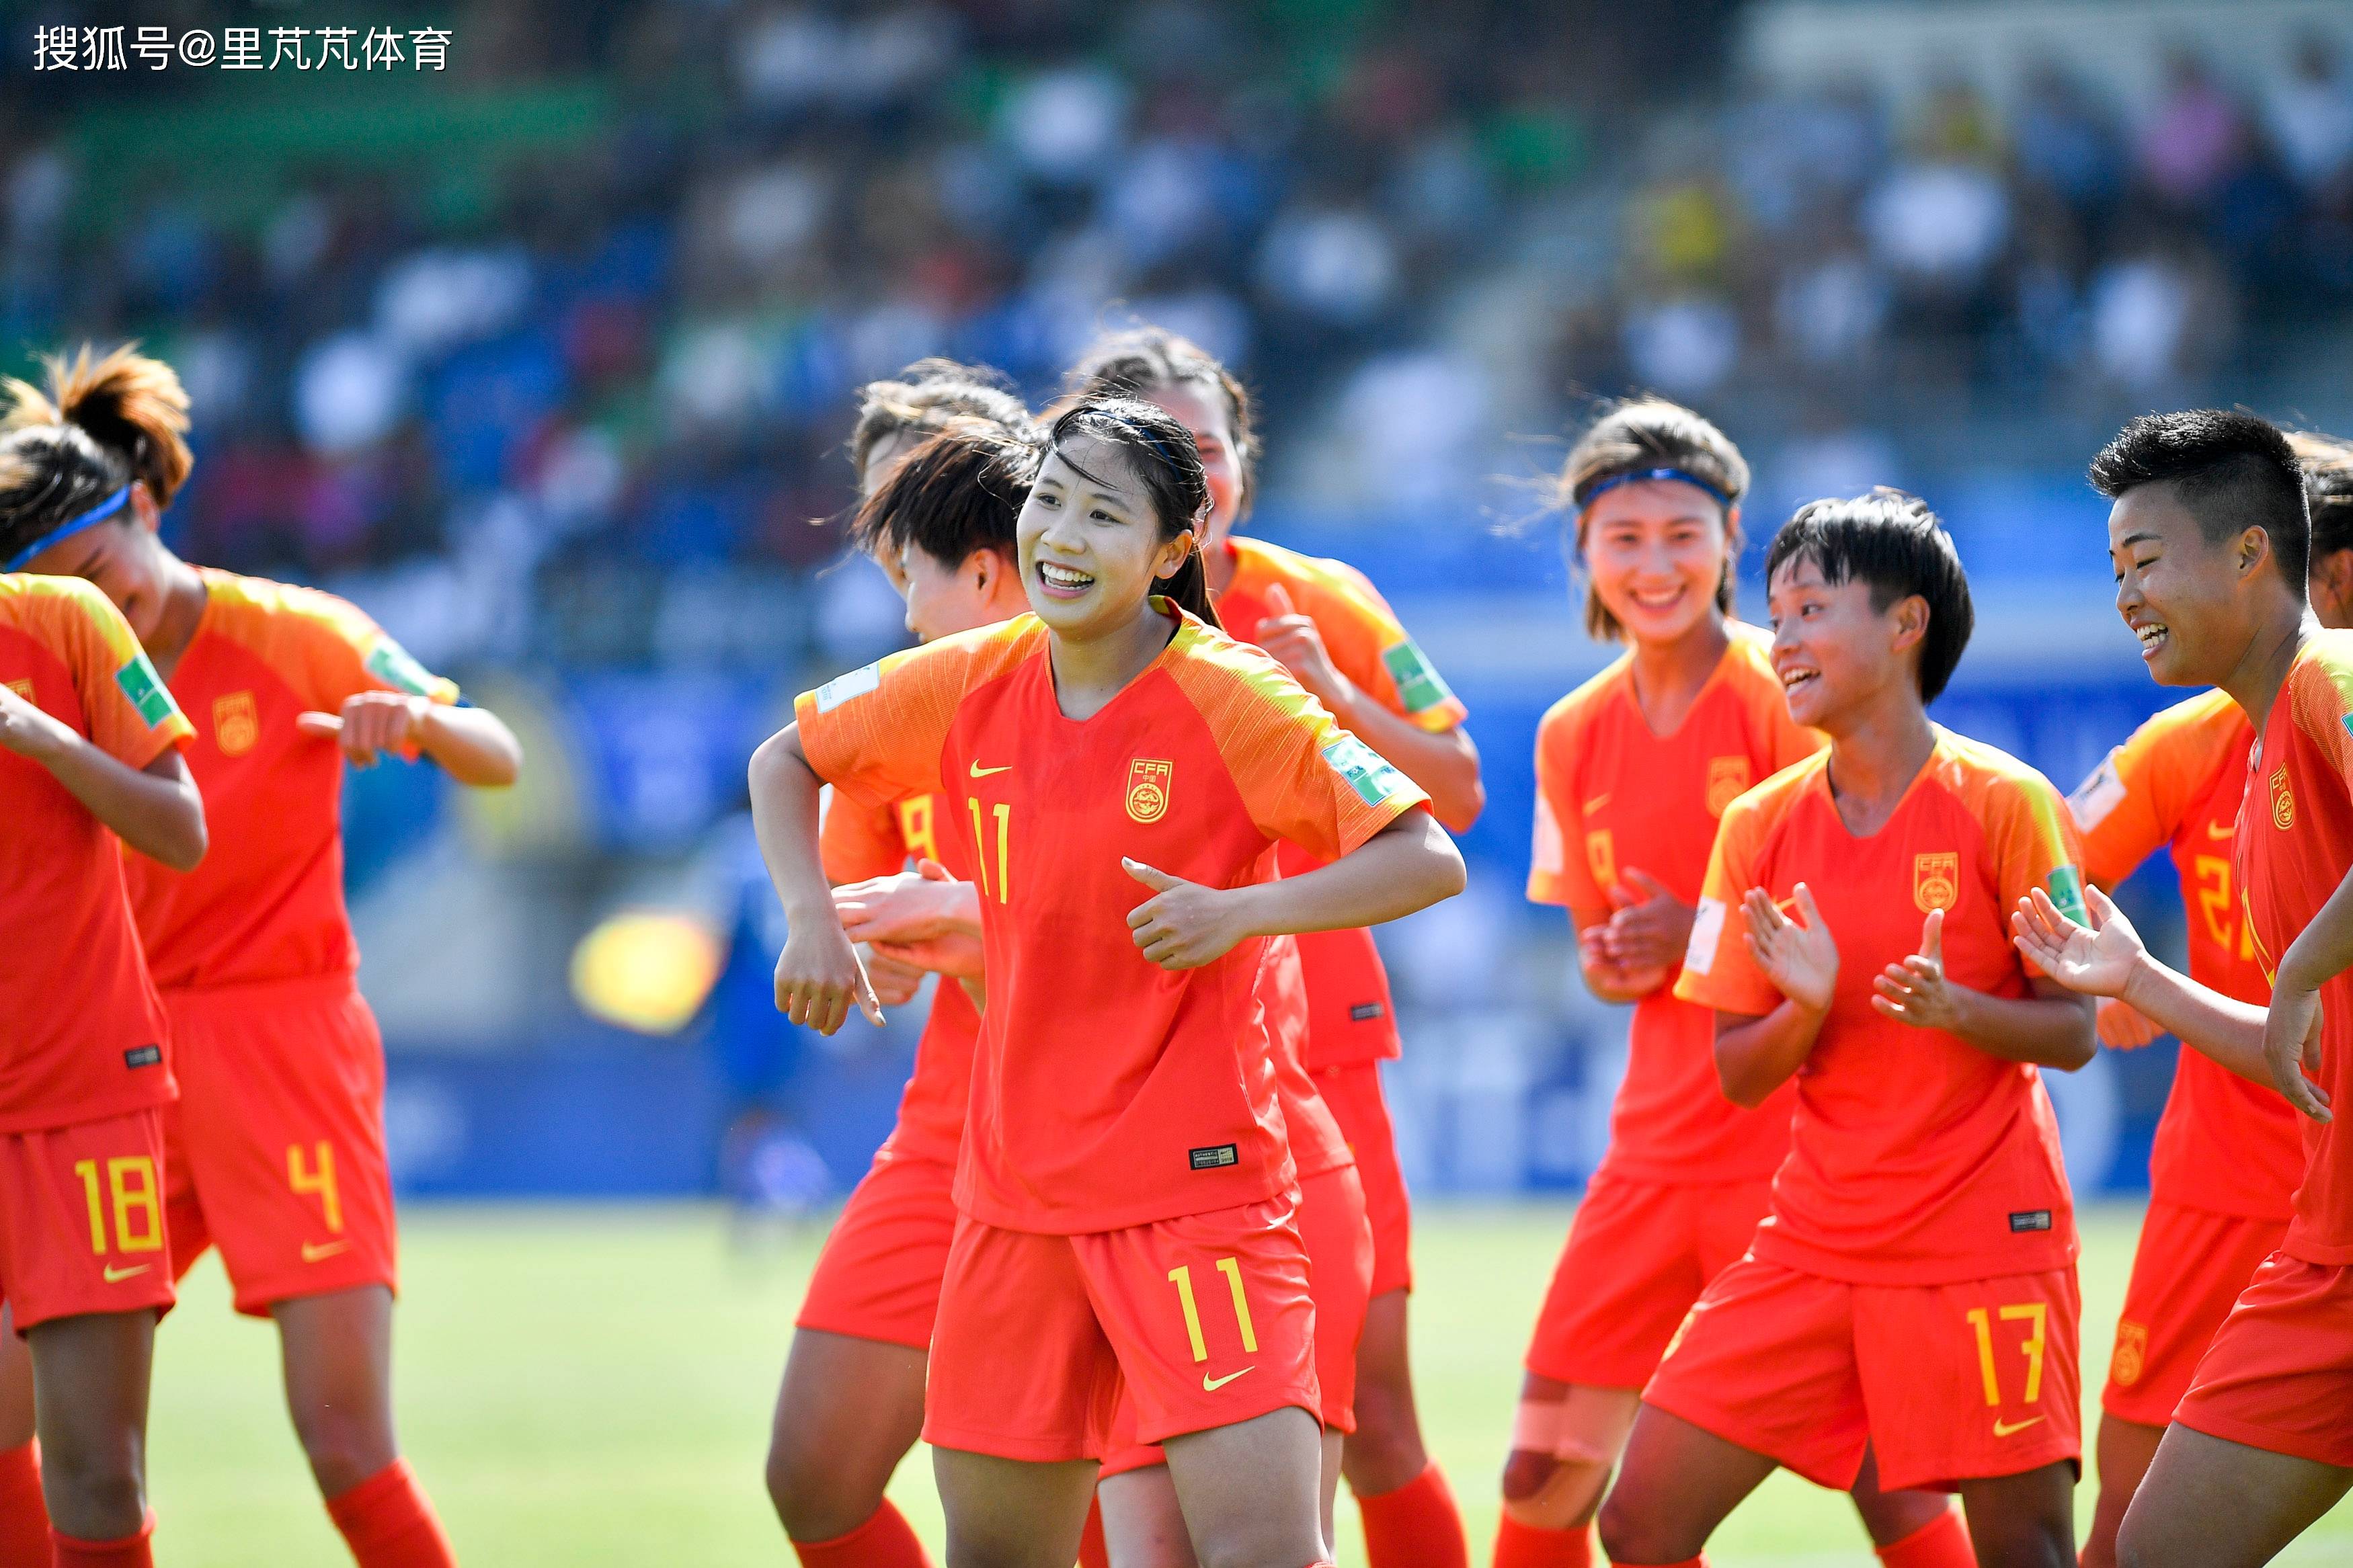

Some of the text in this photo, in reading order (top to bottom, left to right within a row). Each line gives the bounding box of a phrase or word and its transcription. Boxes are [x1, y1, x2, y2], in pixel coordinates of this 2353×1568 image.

[1133, 761, 1169, 776] CFA
[900, 793, 940, 863] 9
[968, 797, 1011, 904] 11
[75, 1155, 163, 1255] 18
[286, 1141, 344, 1234] 4
[1168, 1256, 1259, 1362] 11
[1966, 1303, 2047, 1407] 17
